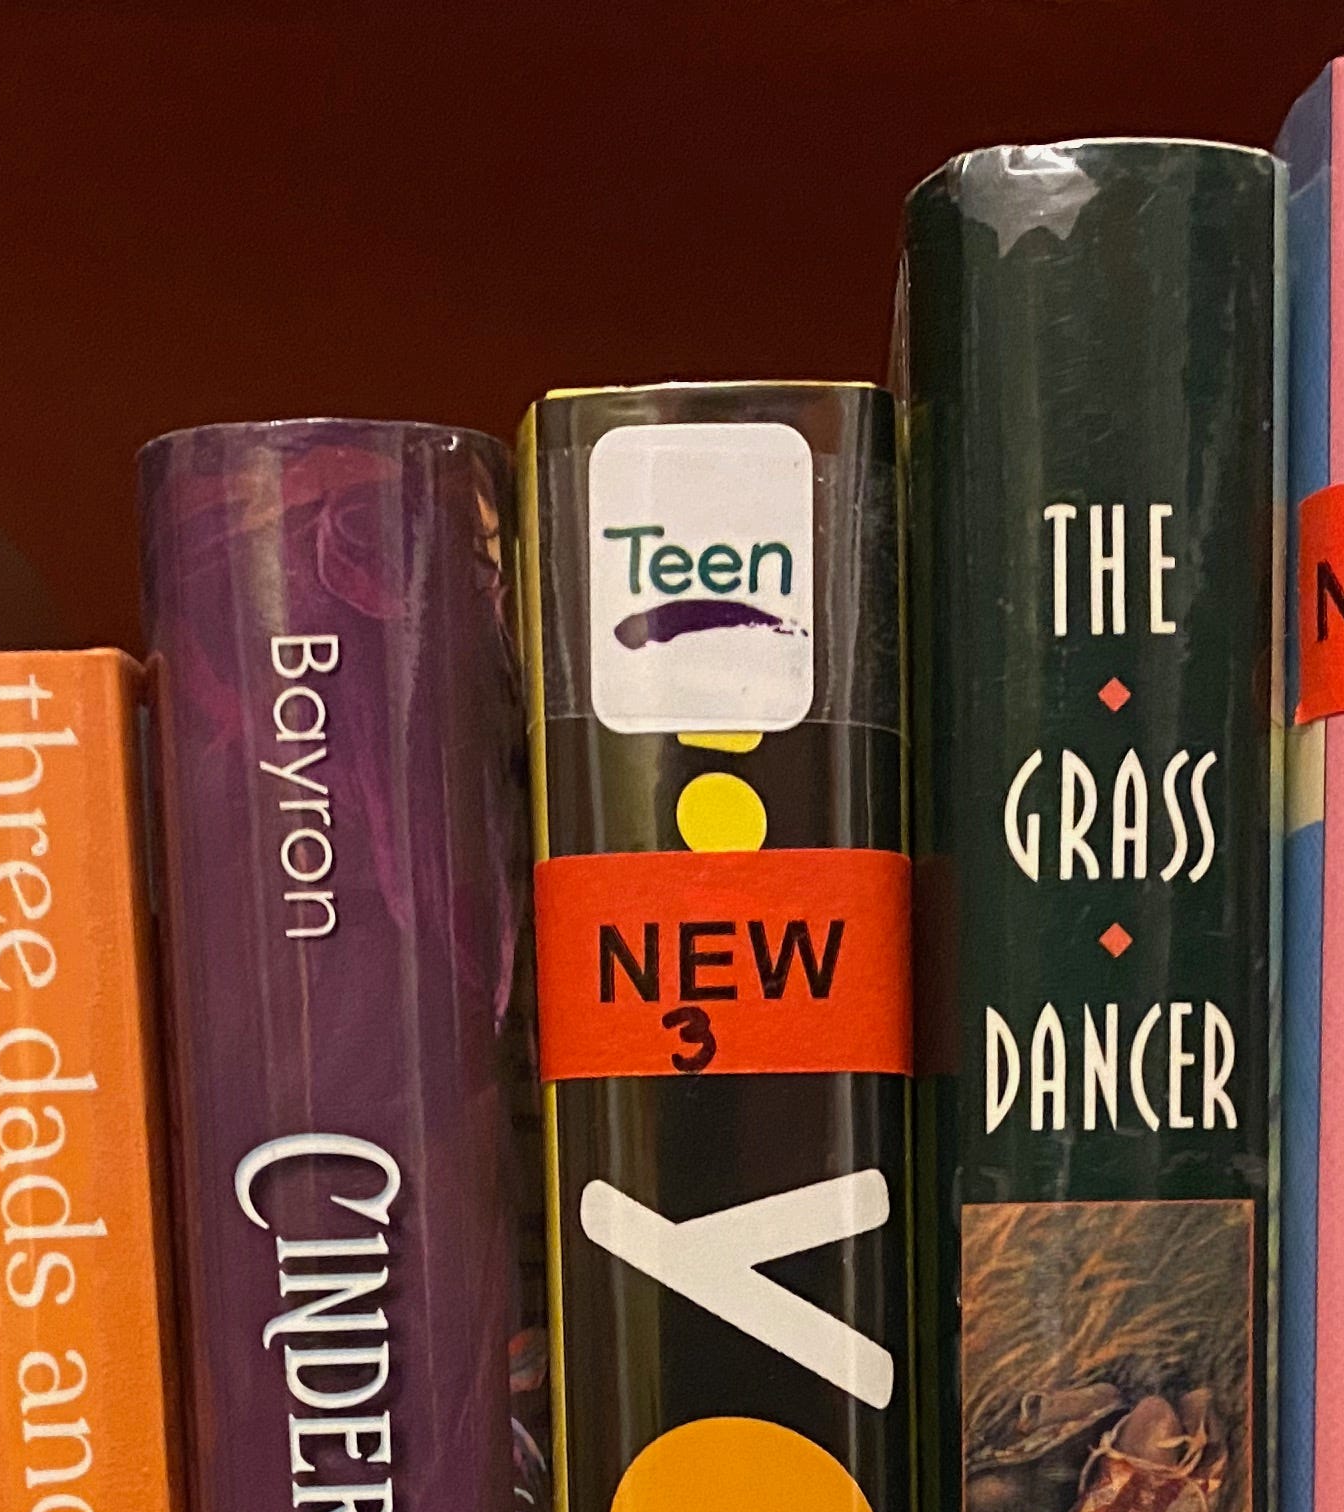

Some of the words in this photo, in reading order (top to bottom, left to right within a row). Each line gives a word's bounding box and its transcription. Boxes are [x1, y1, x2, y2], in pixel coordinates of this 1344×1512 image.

[603, 526, 794, 596] Teen
[1043, 503, 1177, 636] THE
[258, 633, 341, 940] Bayron
[1003, 748, 1217, 882] GRASS
[598, 918, 847, 1004] NEW
[662, 1006, 719, 1075] 3
[984, 1002, 1237, 1134] DANCER
